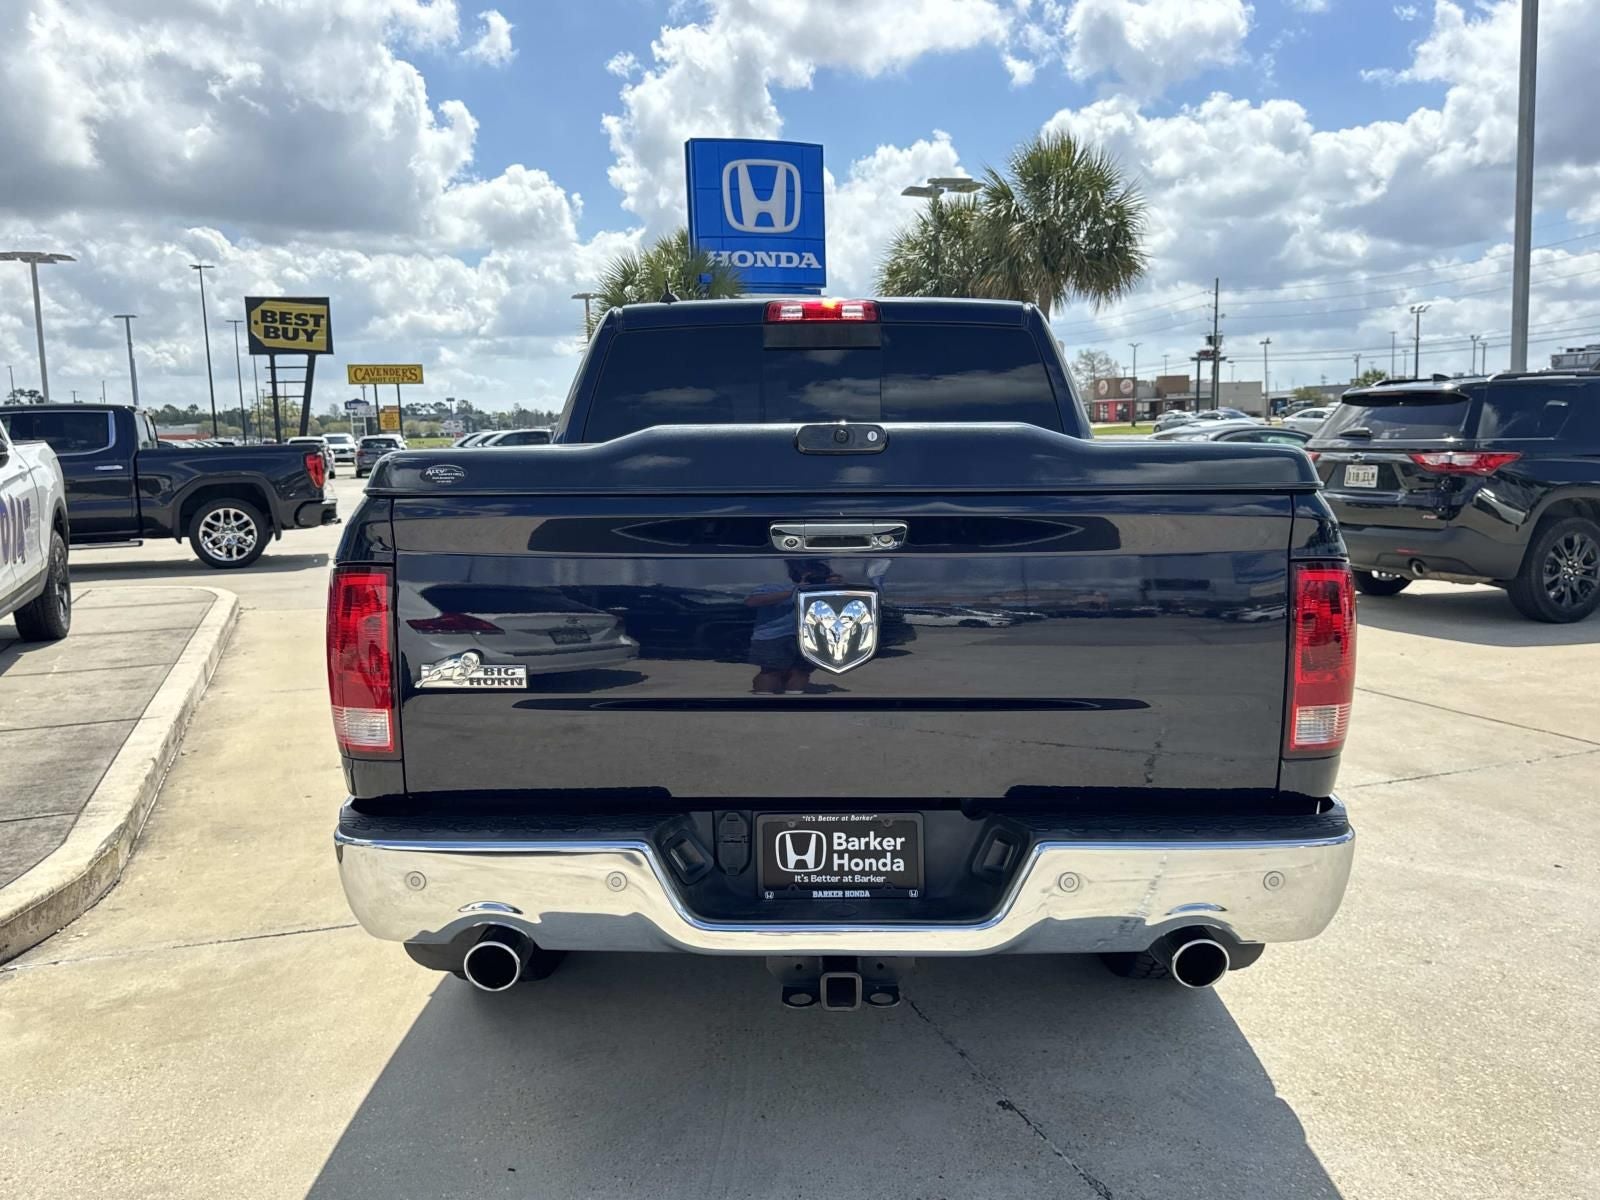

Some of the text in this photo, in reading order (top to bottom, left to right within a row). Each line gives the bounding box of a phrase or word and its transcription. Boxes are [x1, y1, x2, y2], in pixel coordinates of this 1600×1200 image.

[705, 250, 822, 269] HONDA
[261, 310, 325, 328] BEST
[263, 325, 319, 343] BUY
[354, 368, 418, 382] CAVENDER'S
[483, 667, 516, 677] BIG
[468, 677, 525, 686] HORN
[817, 814, 839, 822] Better
[832, 831, 906, 851] Barker
[832, 852, 905, 872] Honda
[794, 874, 886, 883] It's Better at Barker
[812, 890, 871, 898] BARKER HONDA
